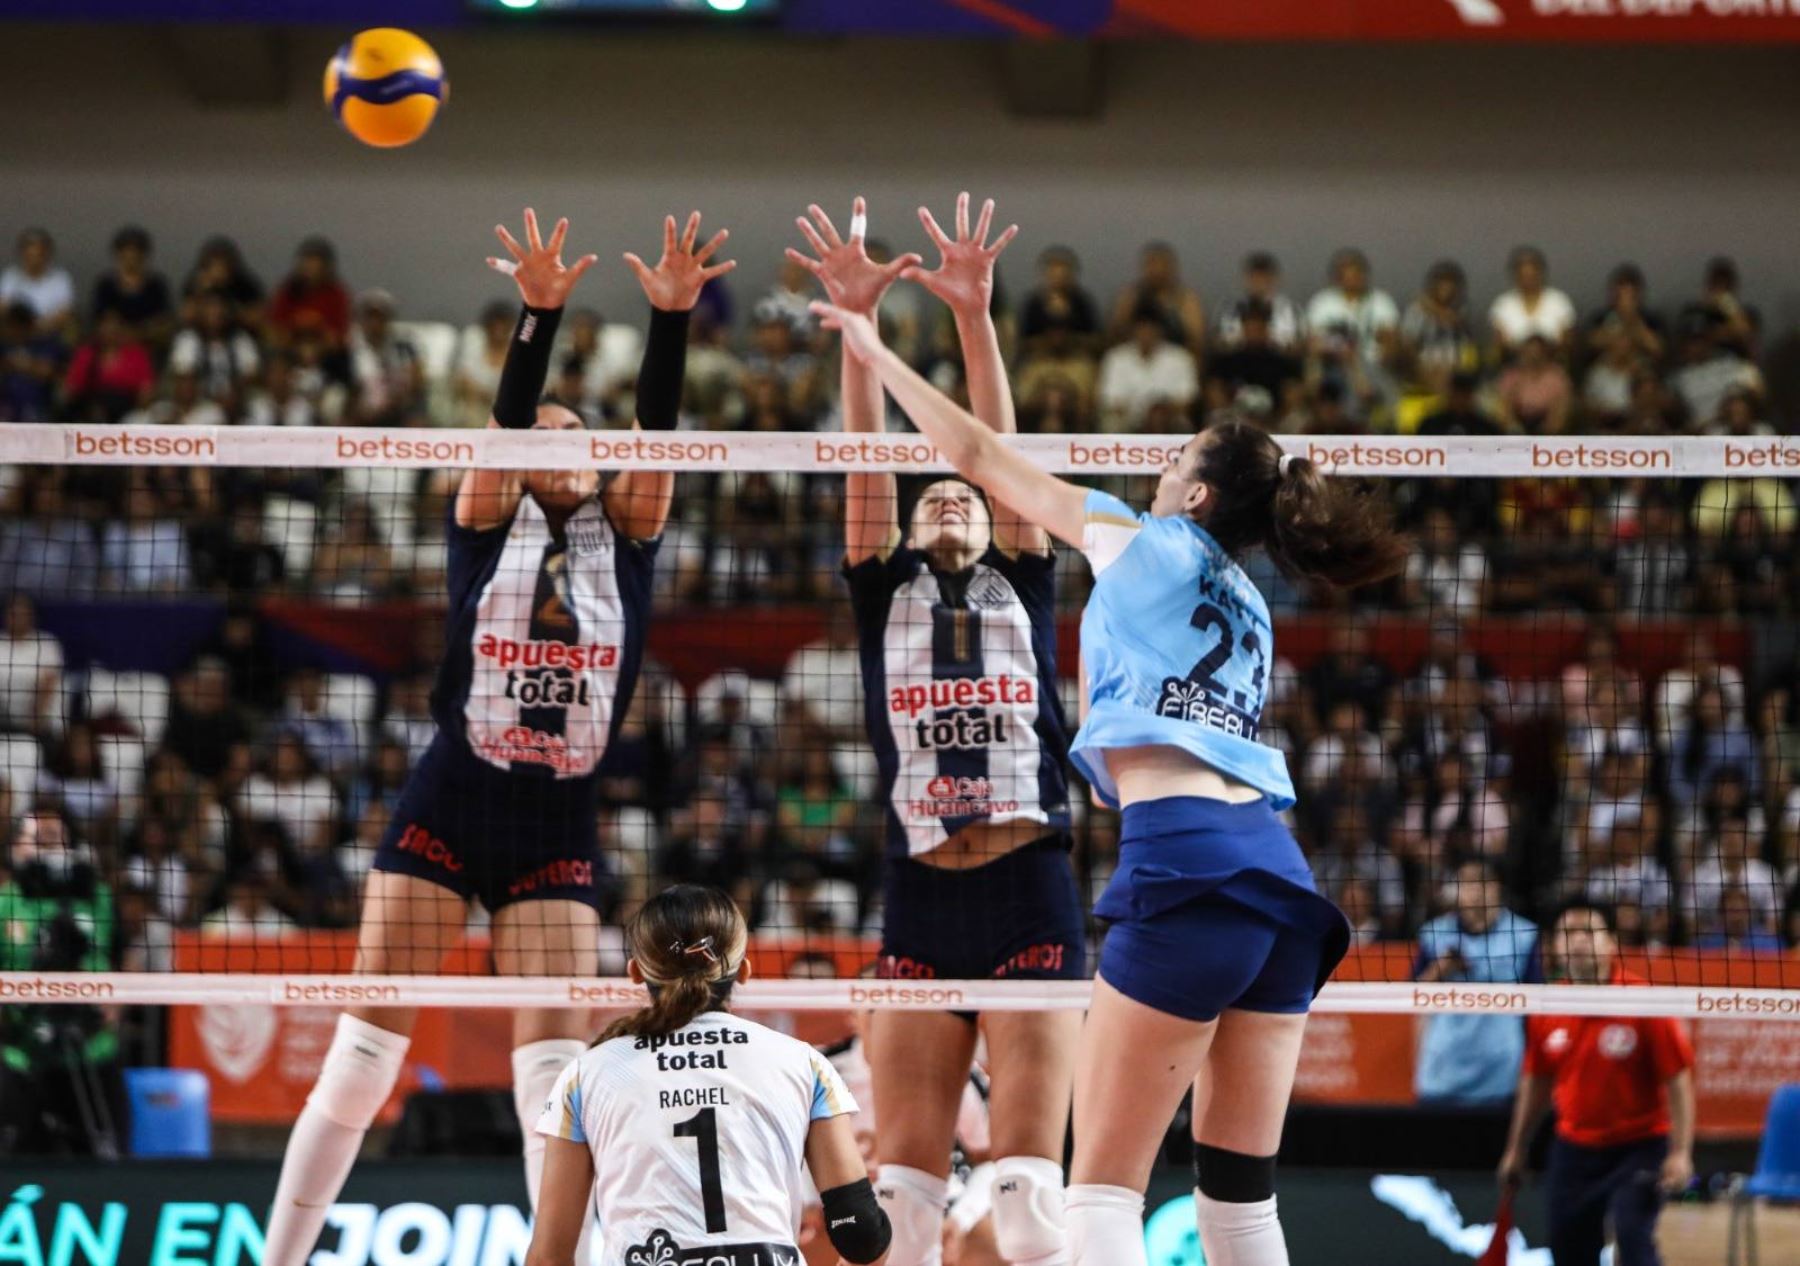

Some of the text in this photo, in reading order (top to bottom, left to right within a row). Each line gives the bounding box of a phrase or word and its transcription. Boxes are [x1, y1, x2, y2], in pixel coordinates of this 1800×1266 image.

[76, 431, 214, 456] betsson
[337, 435, 473, 461] betsson
[591, 435, 728, 462] betsson
[1069, 441, 1182, 464] betsso
[1309, 441, 1445, 467] betsson
[1532, 444, 1670, 468] betsson
[479, 634, 617, 671] apuesta
[505, 670, 589, 706] total
[891, 674, 1033, 718] apuesta
[917, 713, 1007, 748] total
[0, 977, 114, 997] betsson
[285, 981, 399, 1000] betsson
[569, 982, 649, 1002] betss
[849, 983, 964, 1003] betsson
[1413, 987, 1528, 1008] betsson
[634, 1027, 749, 1052] apuesta
[656, 1049, 728, 1071] total
[660, 1087, 730, 1109] RACHEL
[673, 1106, 728, 1234] 1
